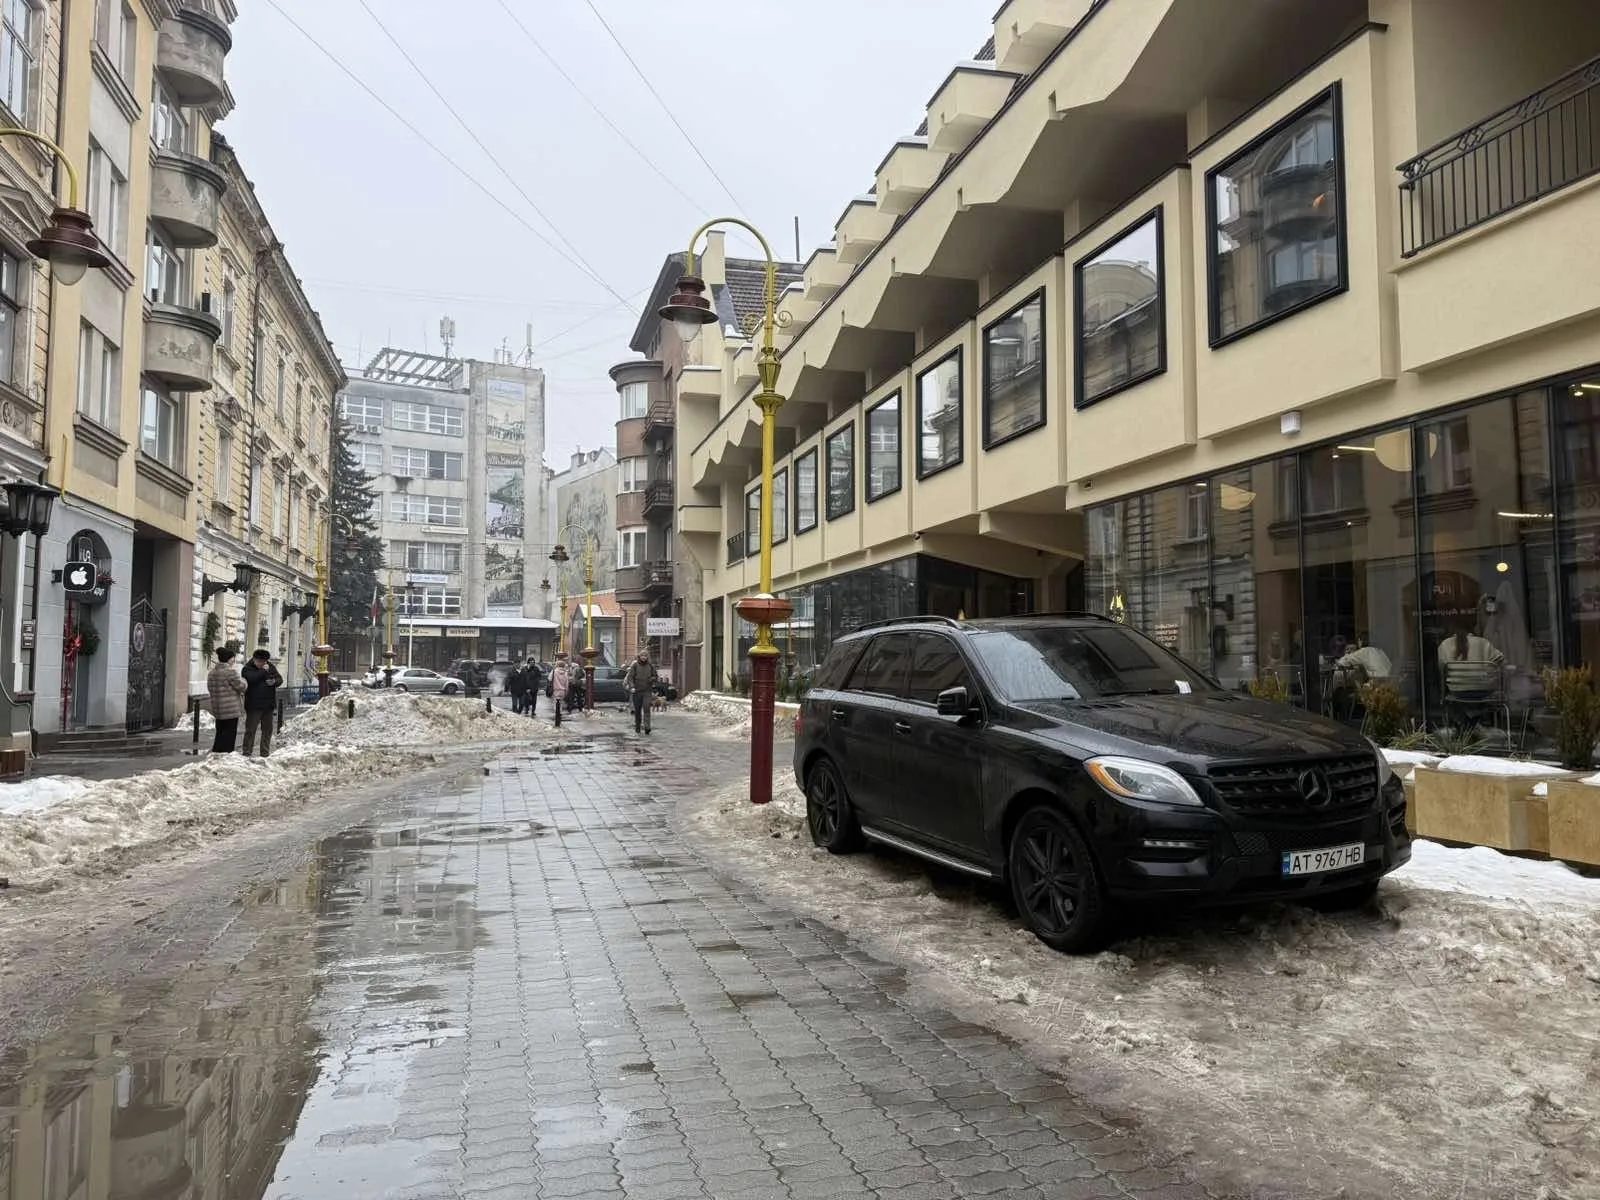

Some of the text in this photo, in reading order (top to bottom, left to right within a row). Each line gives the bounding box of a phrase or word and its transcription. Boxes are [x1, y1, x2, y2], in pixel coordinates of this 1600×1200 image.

[1293, 847, 1361, 872] AT 9767 HB
